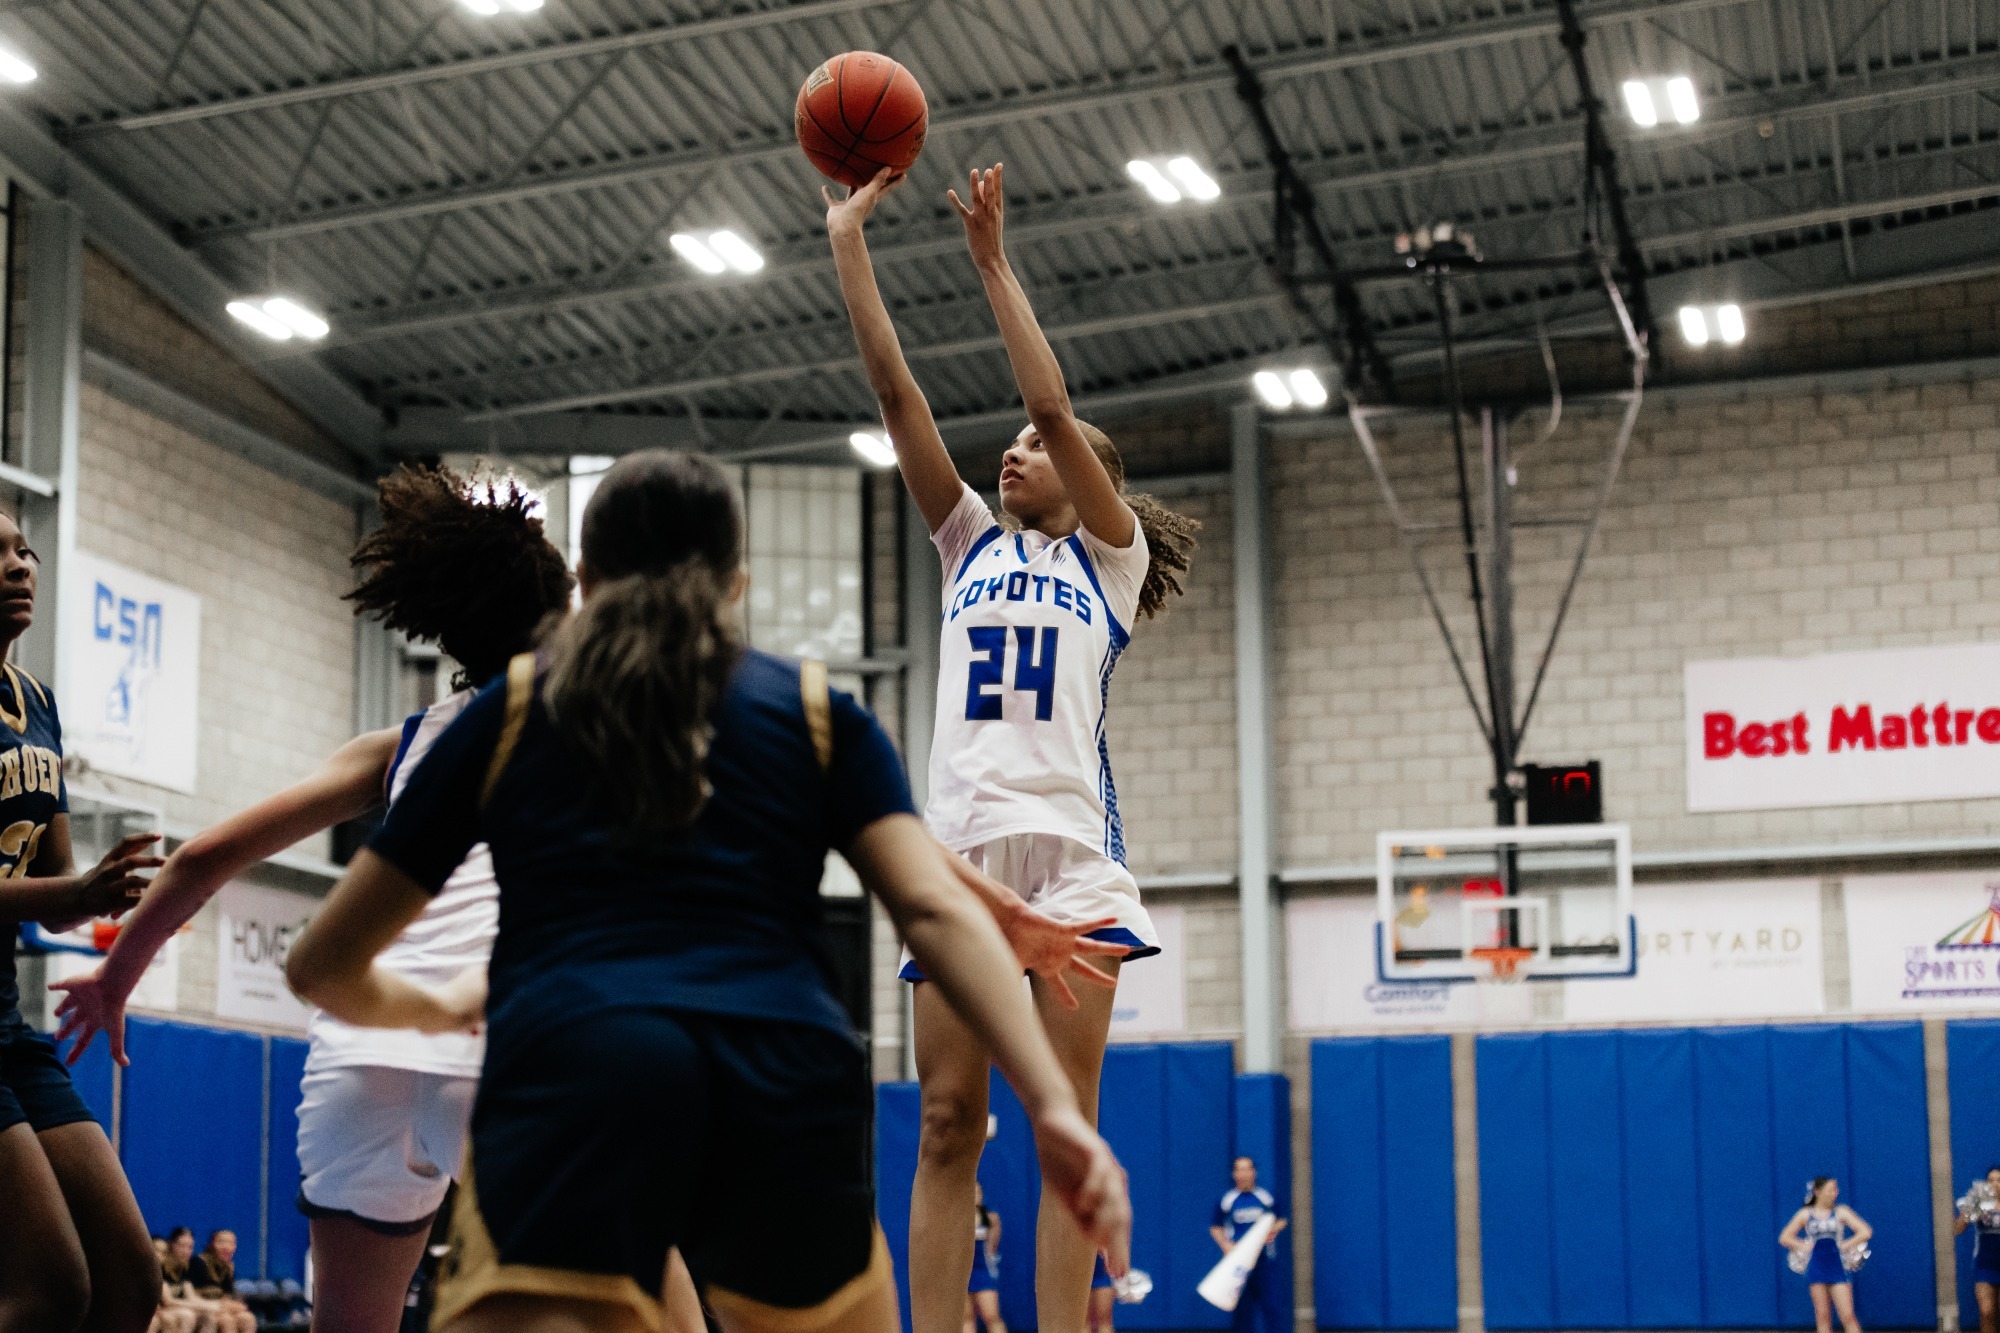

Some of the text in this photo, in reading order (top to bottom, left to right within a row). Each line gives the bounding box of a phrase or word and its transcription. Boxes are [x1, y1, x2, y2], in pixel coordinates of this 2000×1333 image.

[950, 570, 1092, 627] COYOTES
[965, 625, 1059, 722] 24
[1703, 700, 2000, 760] Best Mattre
[1904, 960, 1985, 989] SPORTS
